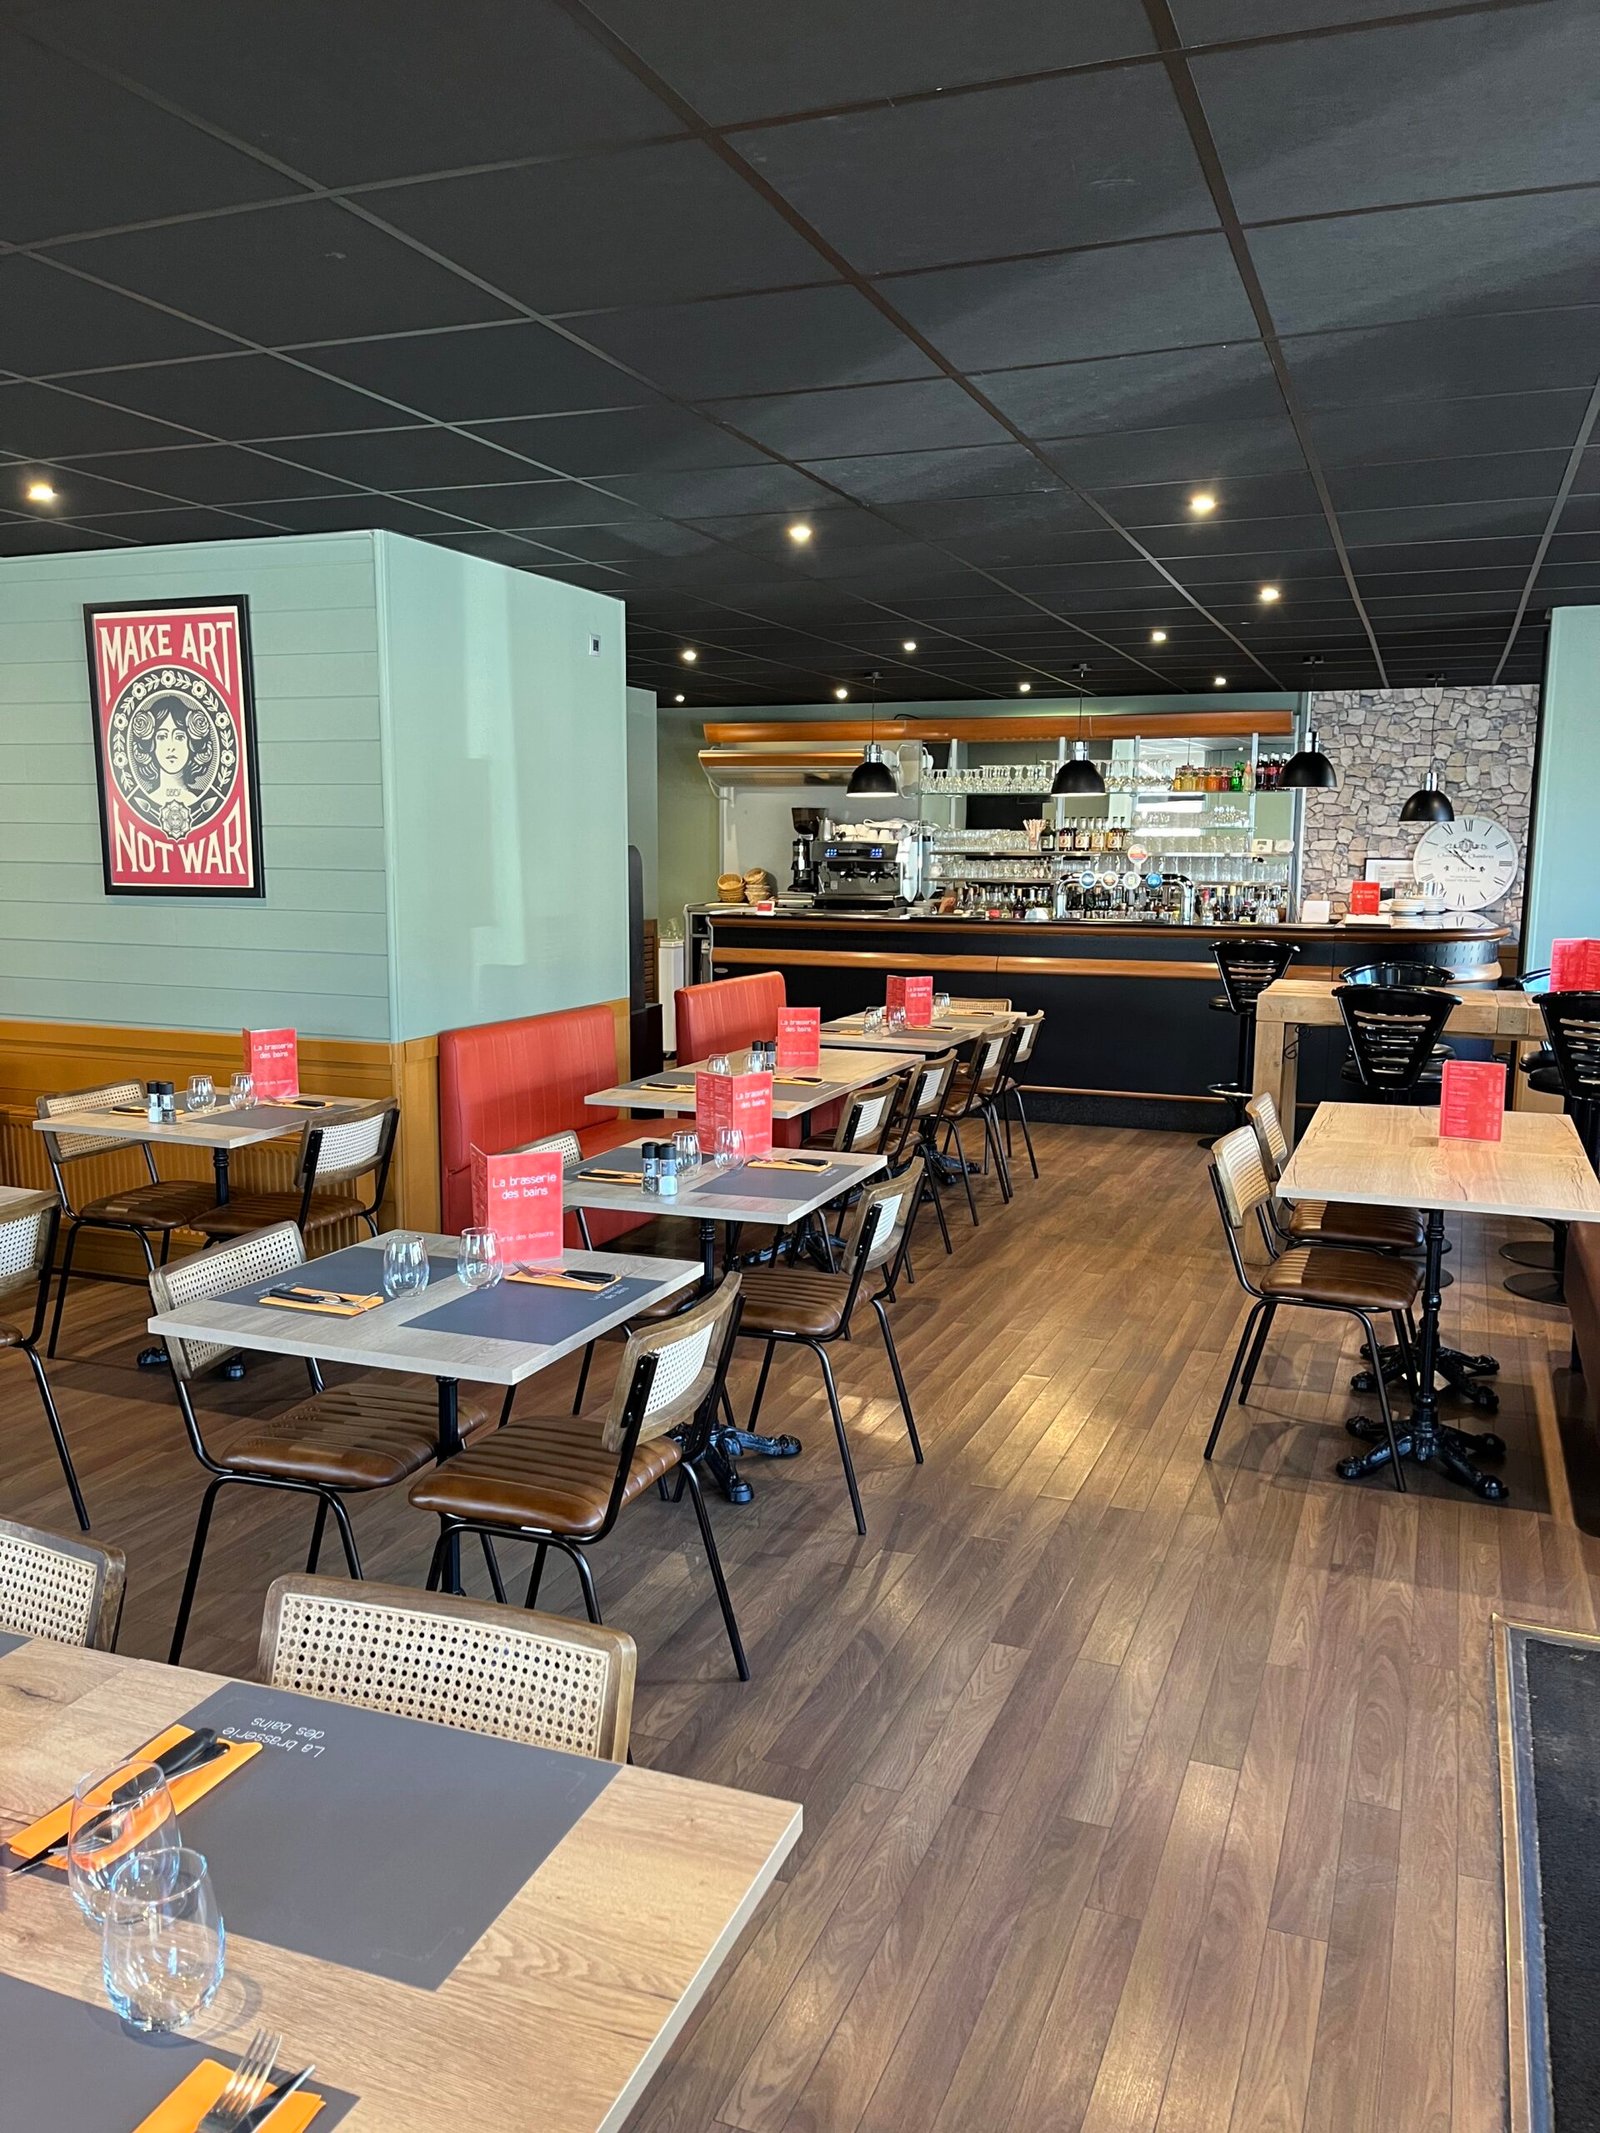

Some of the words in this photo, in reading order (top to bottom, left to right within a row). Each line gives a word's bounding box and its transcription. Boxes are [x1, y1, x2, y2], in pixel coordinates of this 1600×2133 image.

[98, 624, 173, 706] MAKE
[181, 621, 233, 696] ART
[112, 796, 175, 874] NOT
[178, 796, 246, 875] WAR
[253, 1044, 263, 1052] La
[259, 1051, 271, 1059] des
[645, 1163, 653, 1173] P
[492, 1177, 506, 1188] La
[509, 1172, 557, 1187] brasserie
[501, 1188, 519, 1200] des
[523, 1185, 549, 1198] bains
[251, 1717, 293, 1734] bains
[222, 1726, 298, 1752] brasserie
[295, 1726, 325, 1741] des
[301, 1743, 326, 1758] La
